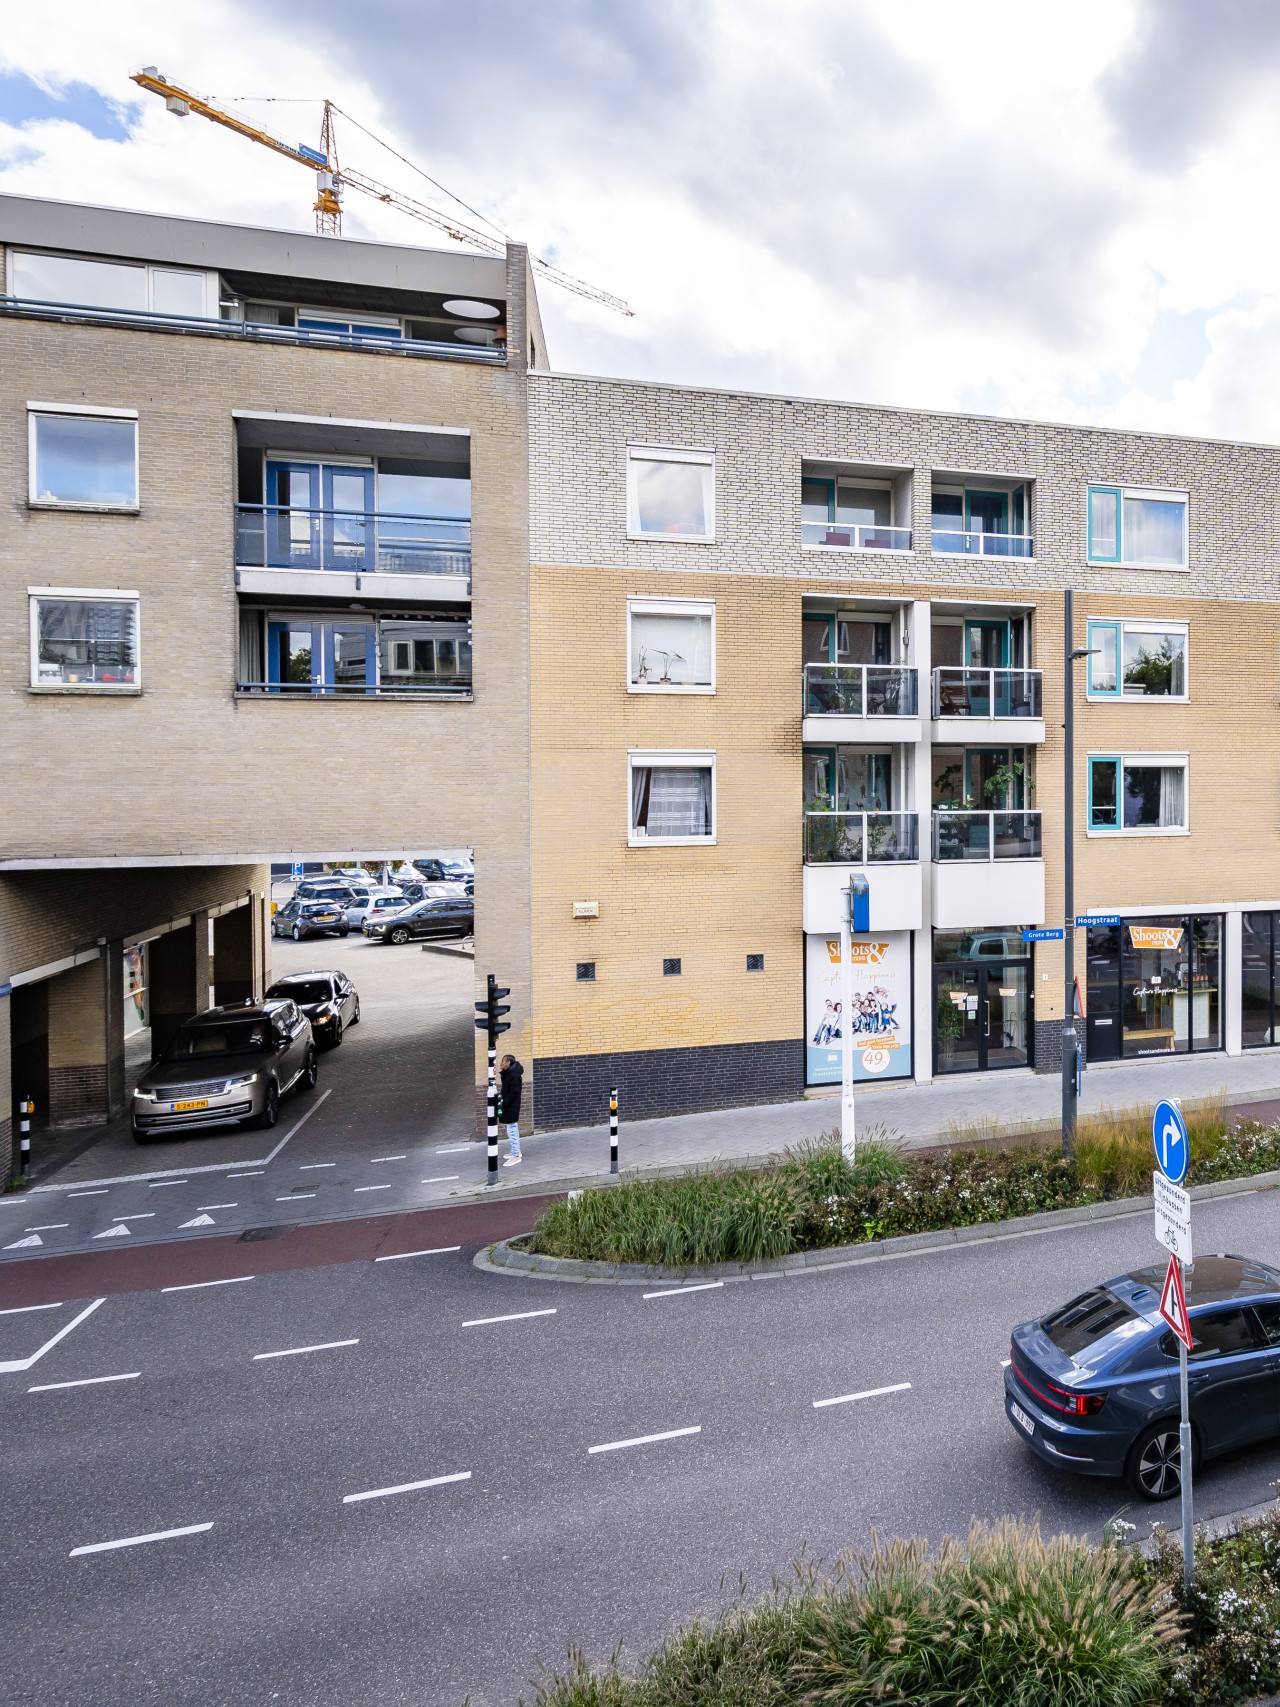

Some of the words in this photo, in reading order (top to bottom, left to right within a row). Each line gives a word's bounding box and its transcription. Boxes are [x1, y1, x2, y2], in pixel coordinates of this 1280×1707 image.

[1077, 916, 1117, 925] Hoogstraat
[829, 942, 870, 957] Shots
[1155, 1176, 1186, 1205] uitgezonderd
[1156, 1206, 1187, 1235] uitgezonderd
